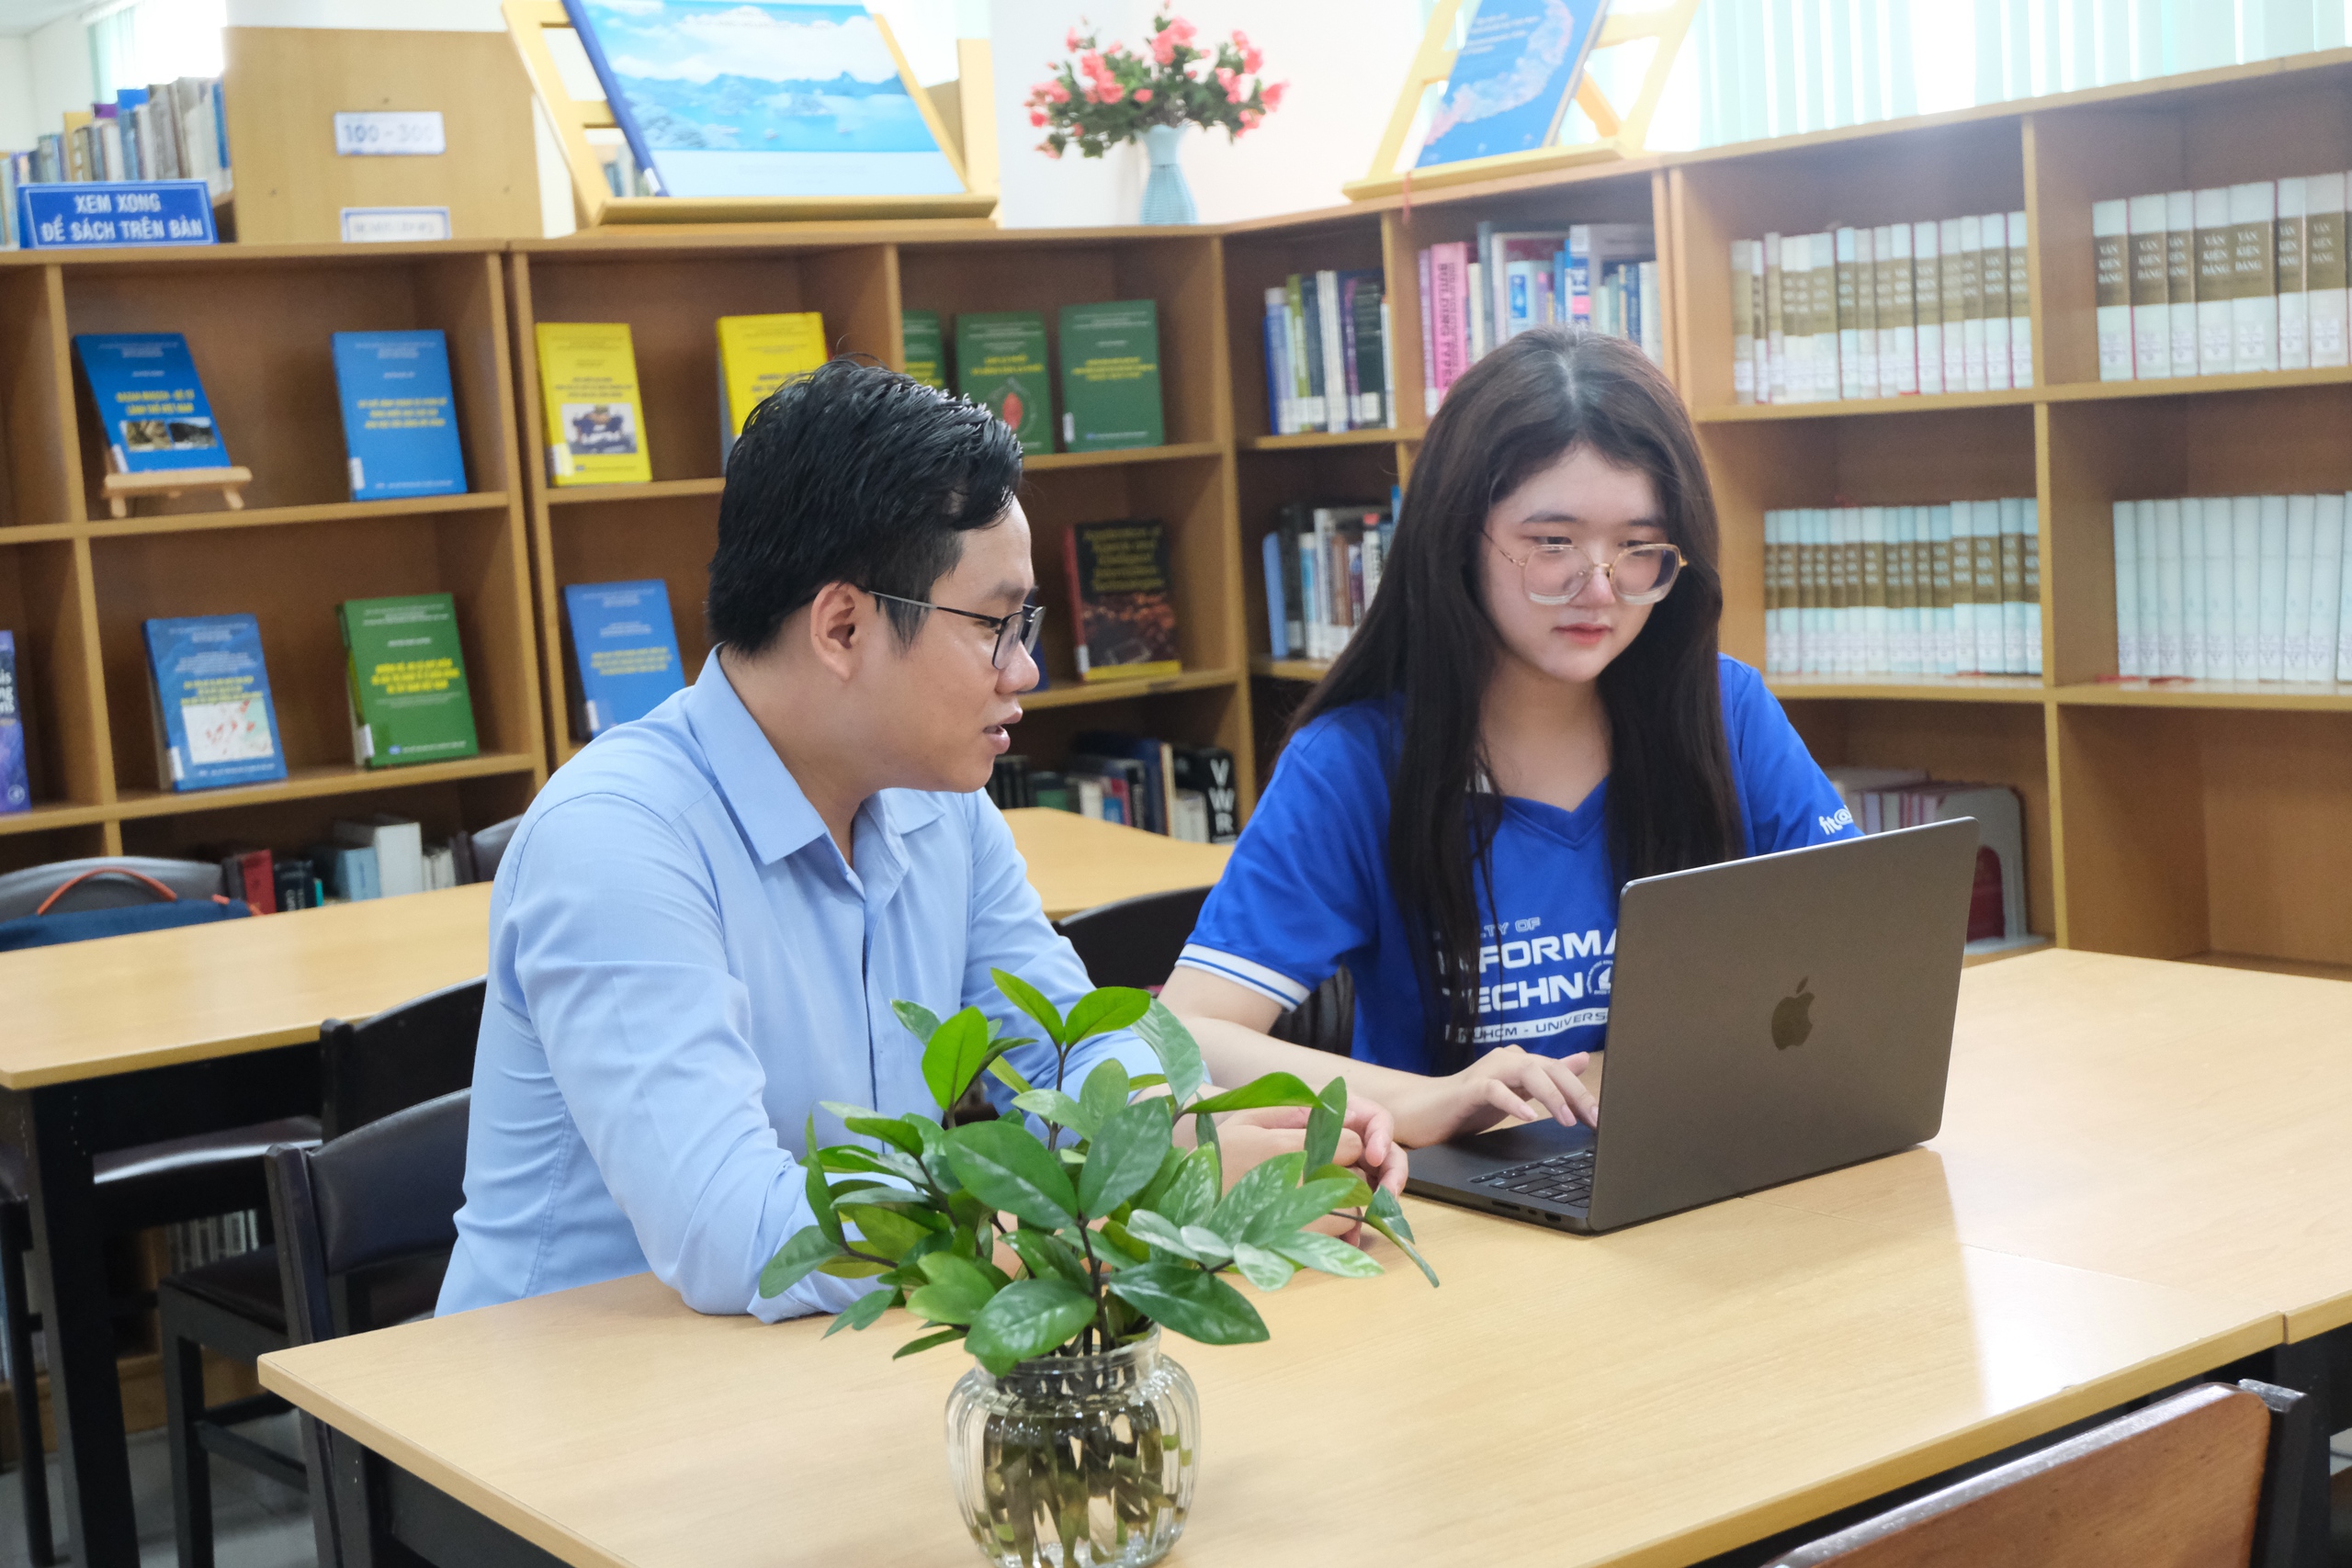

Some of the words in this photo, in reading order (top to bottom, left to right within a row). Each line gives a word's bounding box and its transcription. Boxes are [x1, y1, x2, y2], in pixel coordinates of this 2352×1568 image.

[74, 194, 112, 214] XEM
[116, 193, 162, 213] XONG
[70, 218, 116, 242] SÁCH
[119, 216, 165, 240] TRÊN
[1480, 921, 1510, 938] TY
[1515, 917, 1541, 932] OF
[1467, 971, 1583, 1014] ECHN
